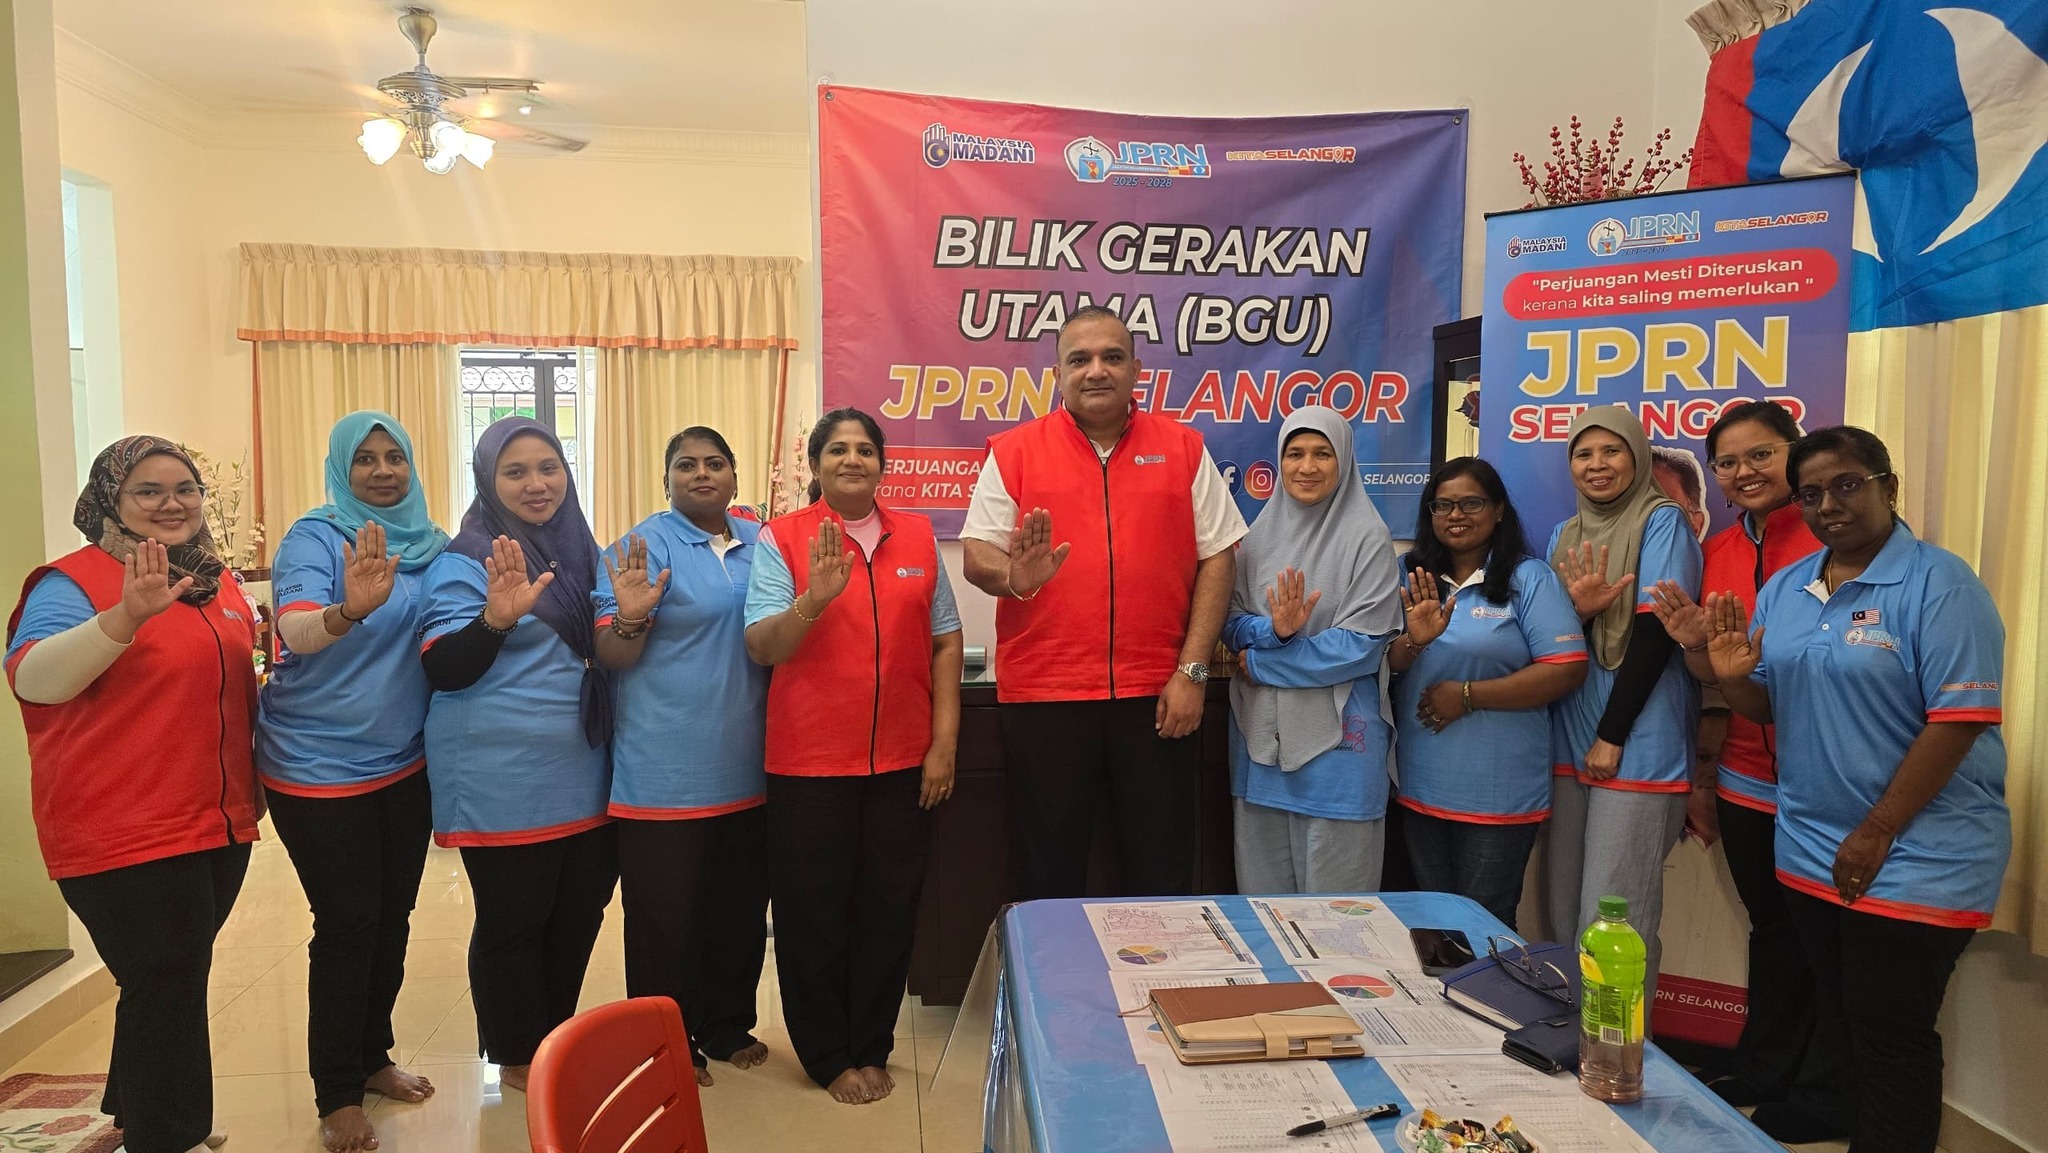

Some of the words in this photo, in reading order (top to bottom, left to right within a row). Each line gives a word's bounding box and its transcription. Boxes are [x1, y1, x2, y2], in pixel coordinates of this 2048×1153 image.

[952, 143, 1034, 162] MADANI
[953, 133, 1033, 149] MALAYSIA
[1116, 142, 1208, 166] JPRN
[1113, 176, 1138, 187] 2025
[1147, 177, 1172, 188] 2028
[1625, 211, 1700, 239] JPRN
[934, 216, 1096, 271] BILIK
[1097, 222, 1371, 276] GERAKAN
[1522, 237, 1567, 247] MALAYSIA
[1522, 243, 1568, 254] MADANI
[1532, 271, 1639, 293] "Perjuangan
[1644, 265, 1693, 283] Mesti
[1697, 257, 1804, 279] Diteruskan
[1522, 297, 1578, 313] kerana
[1582, 294, 1615, 308] kita
[1618, 288, 1673, 306] saling
[1678, 280, 1801, 301] memerlukan
[1176, 292, 1332, 356] (BGU)
[1519, 316, 1790, 397] JPRN
[881, 365, 1058, 420] JPRN
[1132, 367, 1409, 424] ELANGOR
[883, 459, 982, 476] ERJUANGA
[873, 484, 916, 498] rana
[920, 483, 963, 498] KITA
[1677, 993, 1749, 1015] SELANGO
